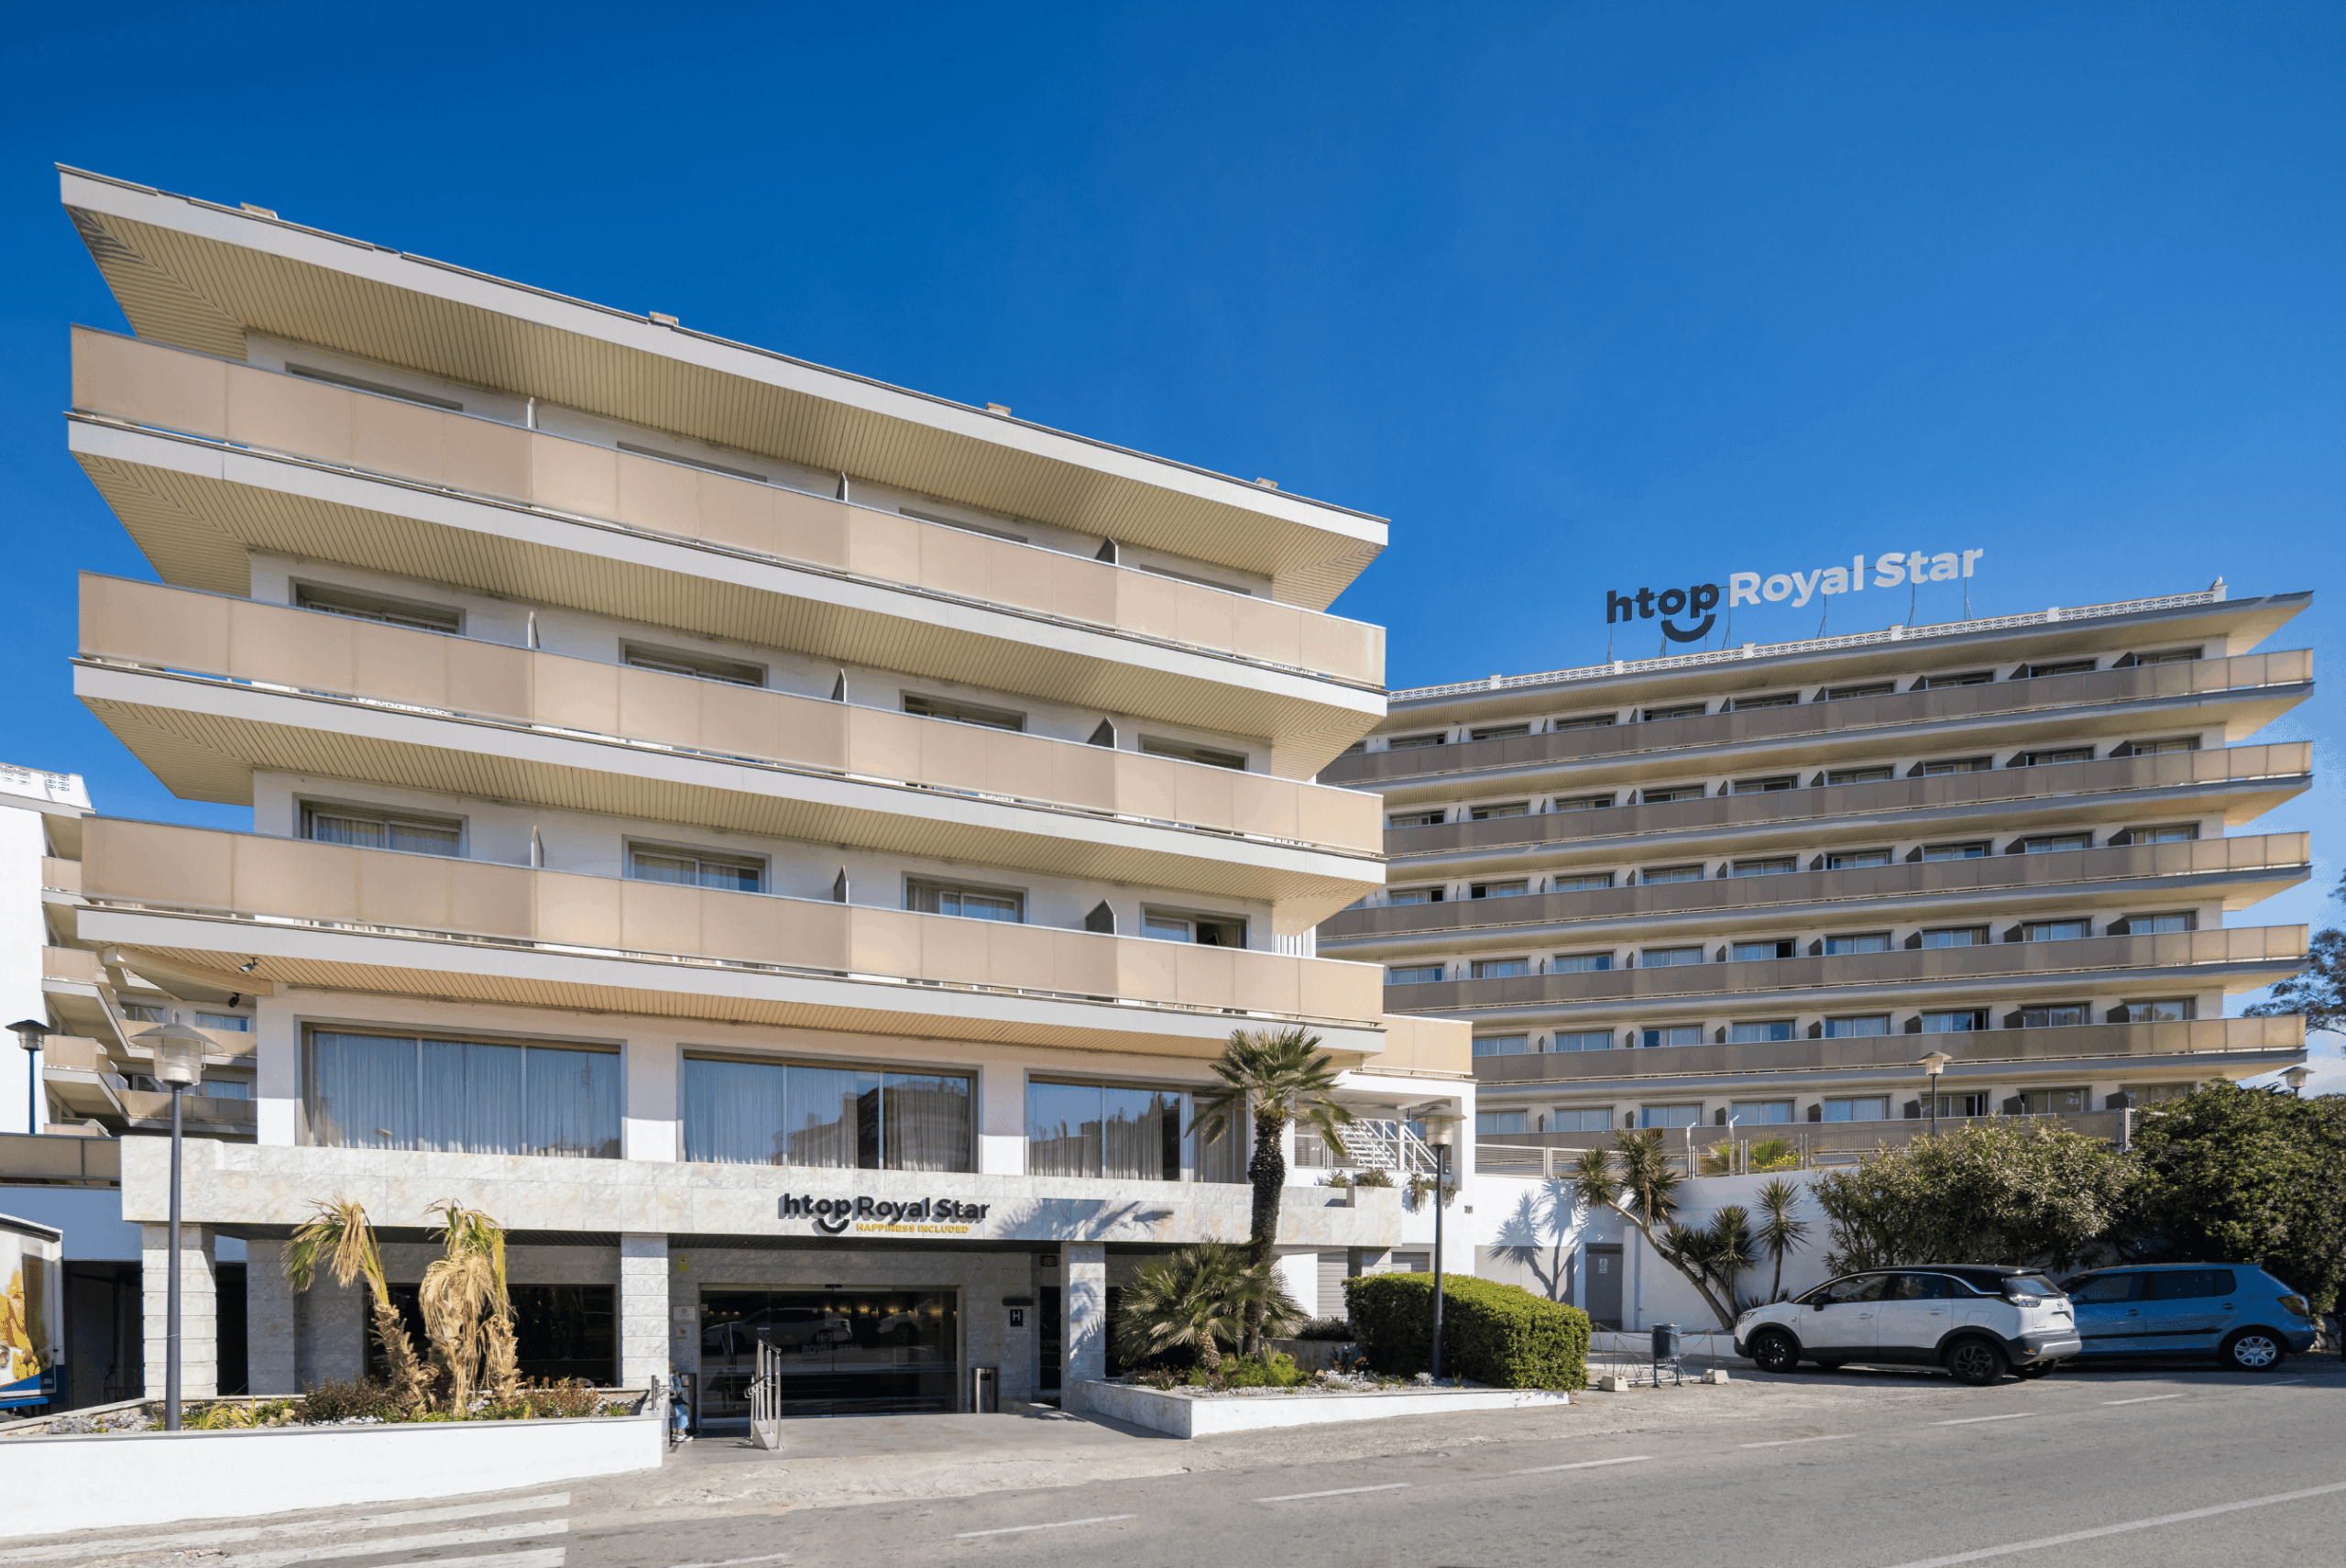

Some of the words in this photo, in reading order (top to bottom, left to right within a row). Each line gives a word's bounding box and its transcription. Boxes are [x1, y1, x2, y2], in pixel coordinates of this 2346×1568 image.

[1606, 582, 1720, 624] htop
[1729, 554, 1865, 608] Royal
[1873, 548, 1984, 588] Star
[784, 1192, 852, 1220] htop
[857, 1195, 931, 1223] Royal
[936, 1198, 991, 1219] Star
[856, 1223, 915, 1234] HAPPINESS
[917, 1224, 970, 1234] INCLUDED
[1012, 1310, 1021, 1321] H
